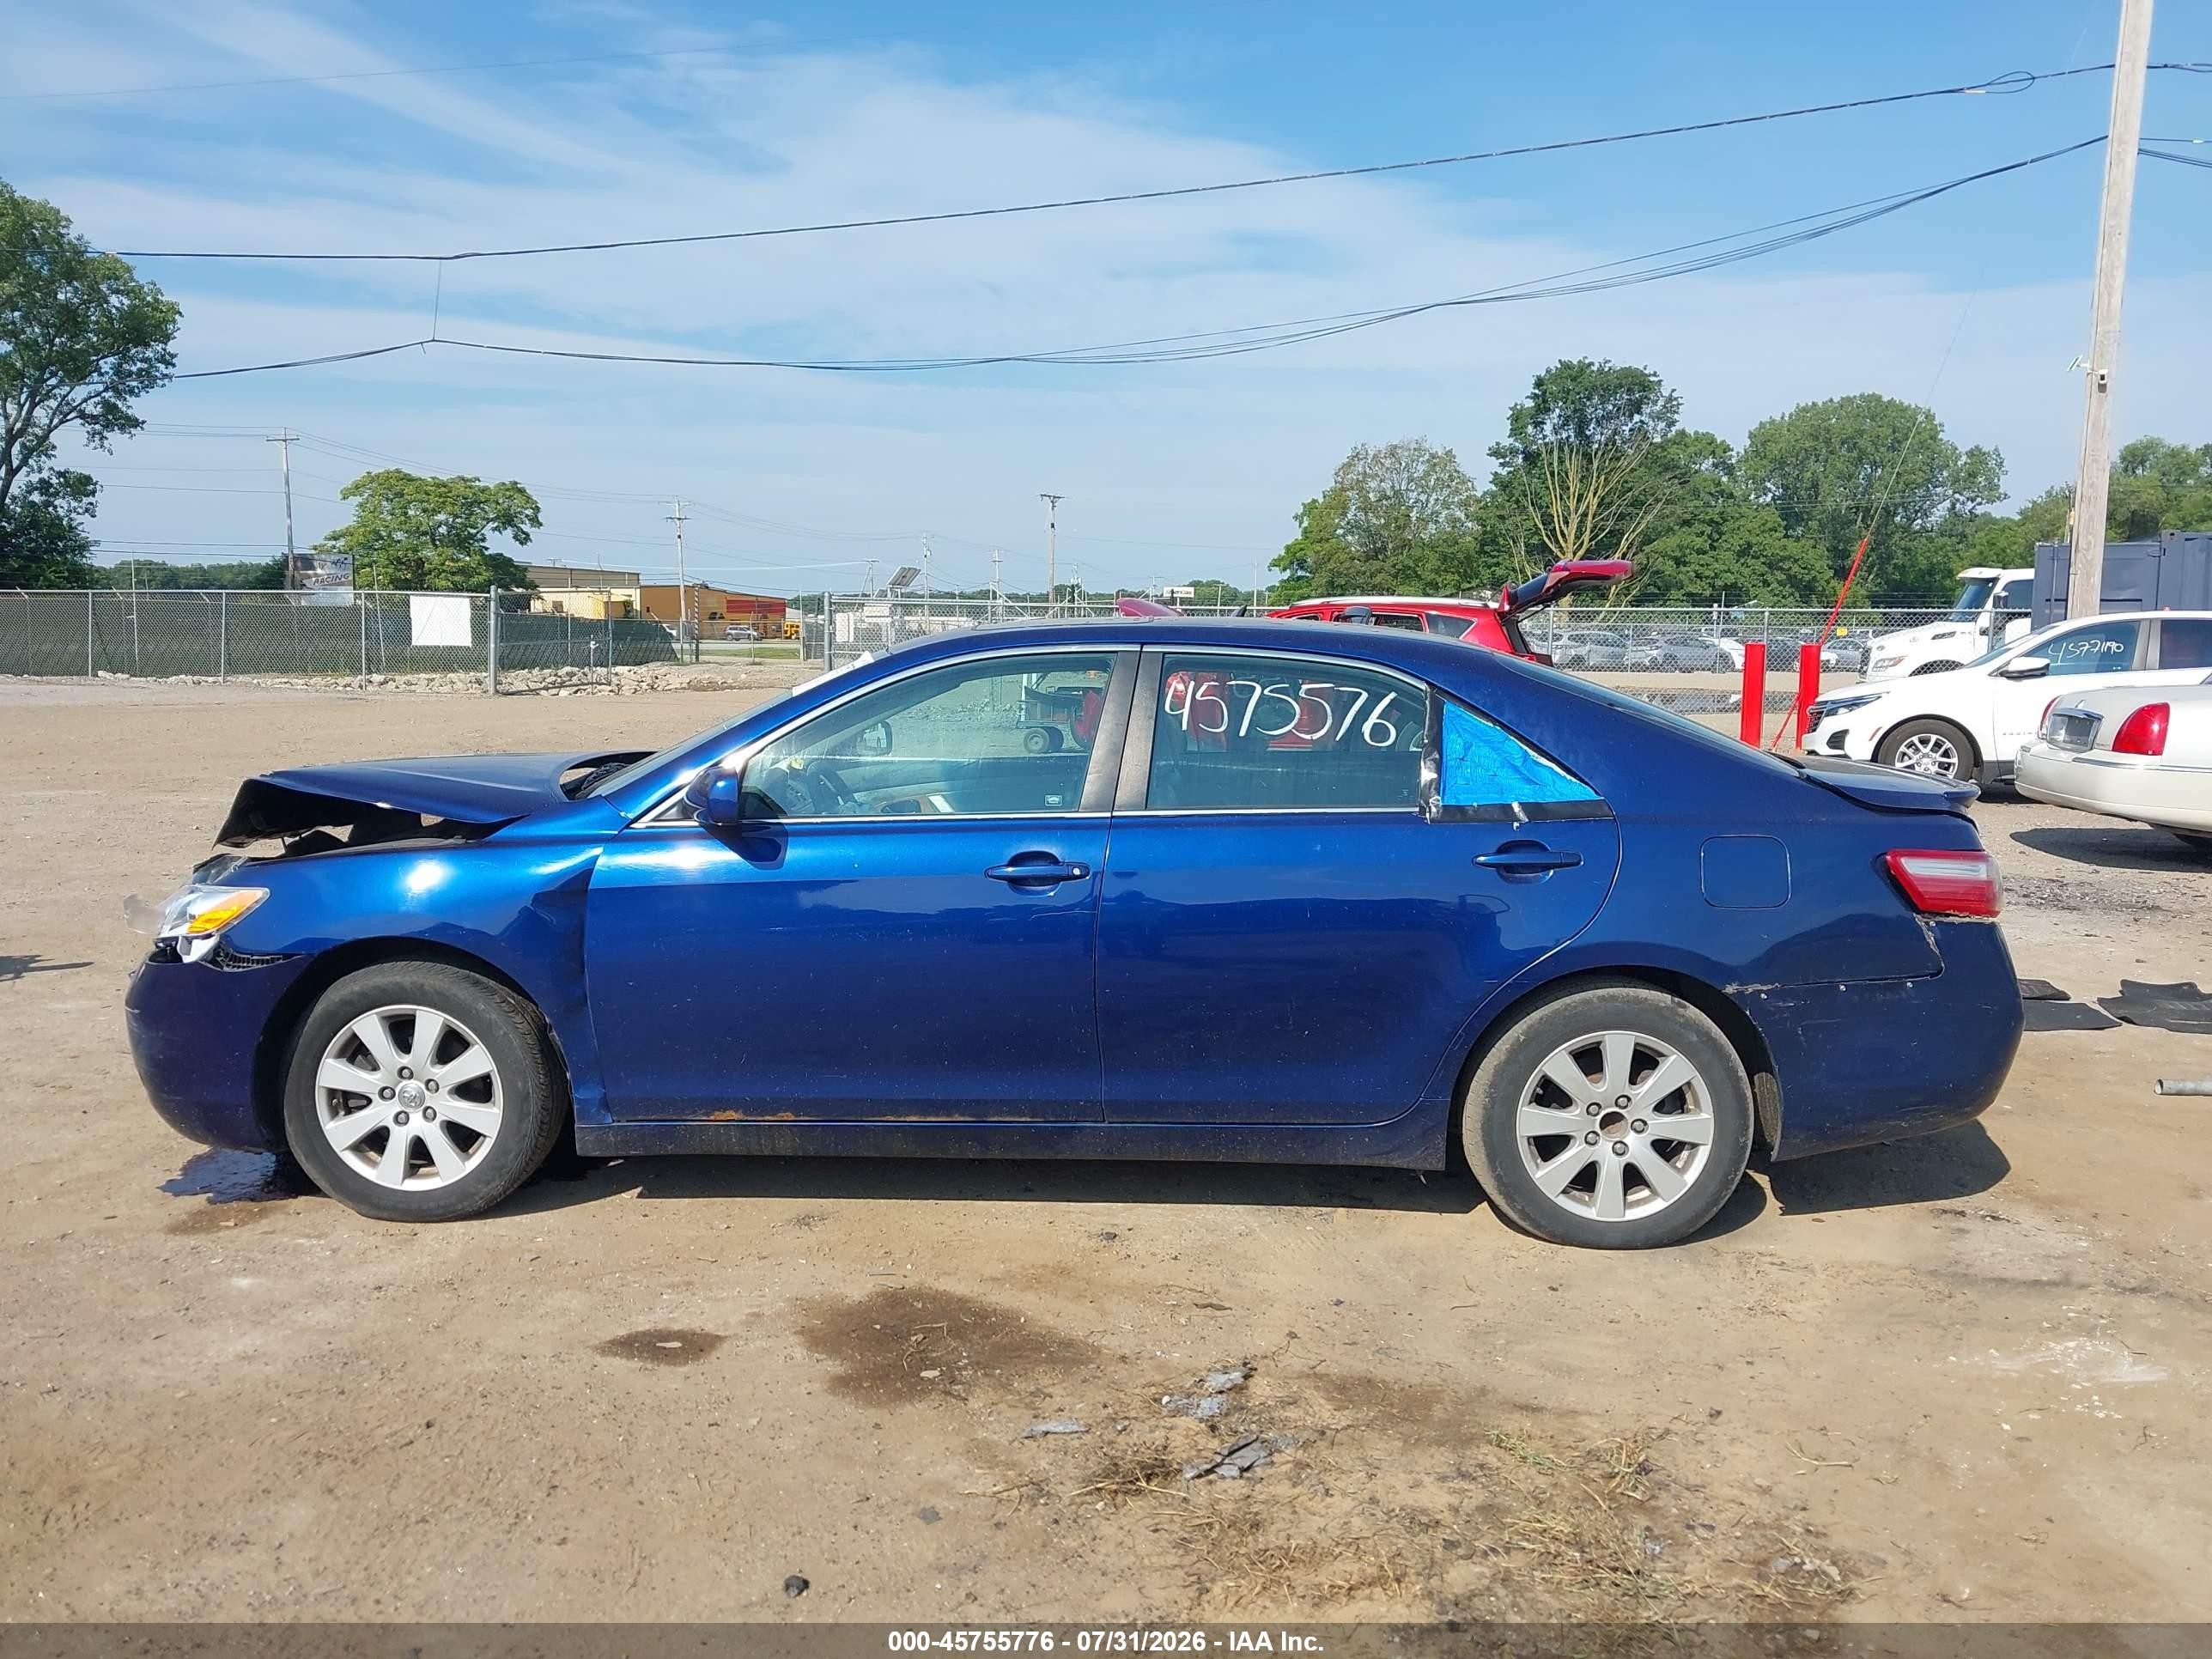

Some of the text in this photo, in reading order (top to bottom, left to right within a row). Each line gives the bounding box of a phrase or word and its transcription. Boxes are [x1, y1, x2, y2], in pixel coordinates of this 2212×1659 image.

[313, 574, 349, 585] RACING
[2048, 640, 2124, 664] 45771190
[1164, 680, 1397, 747] 4575576
